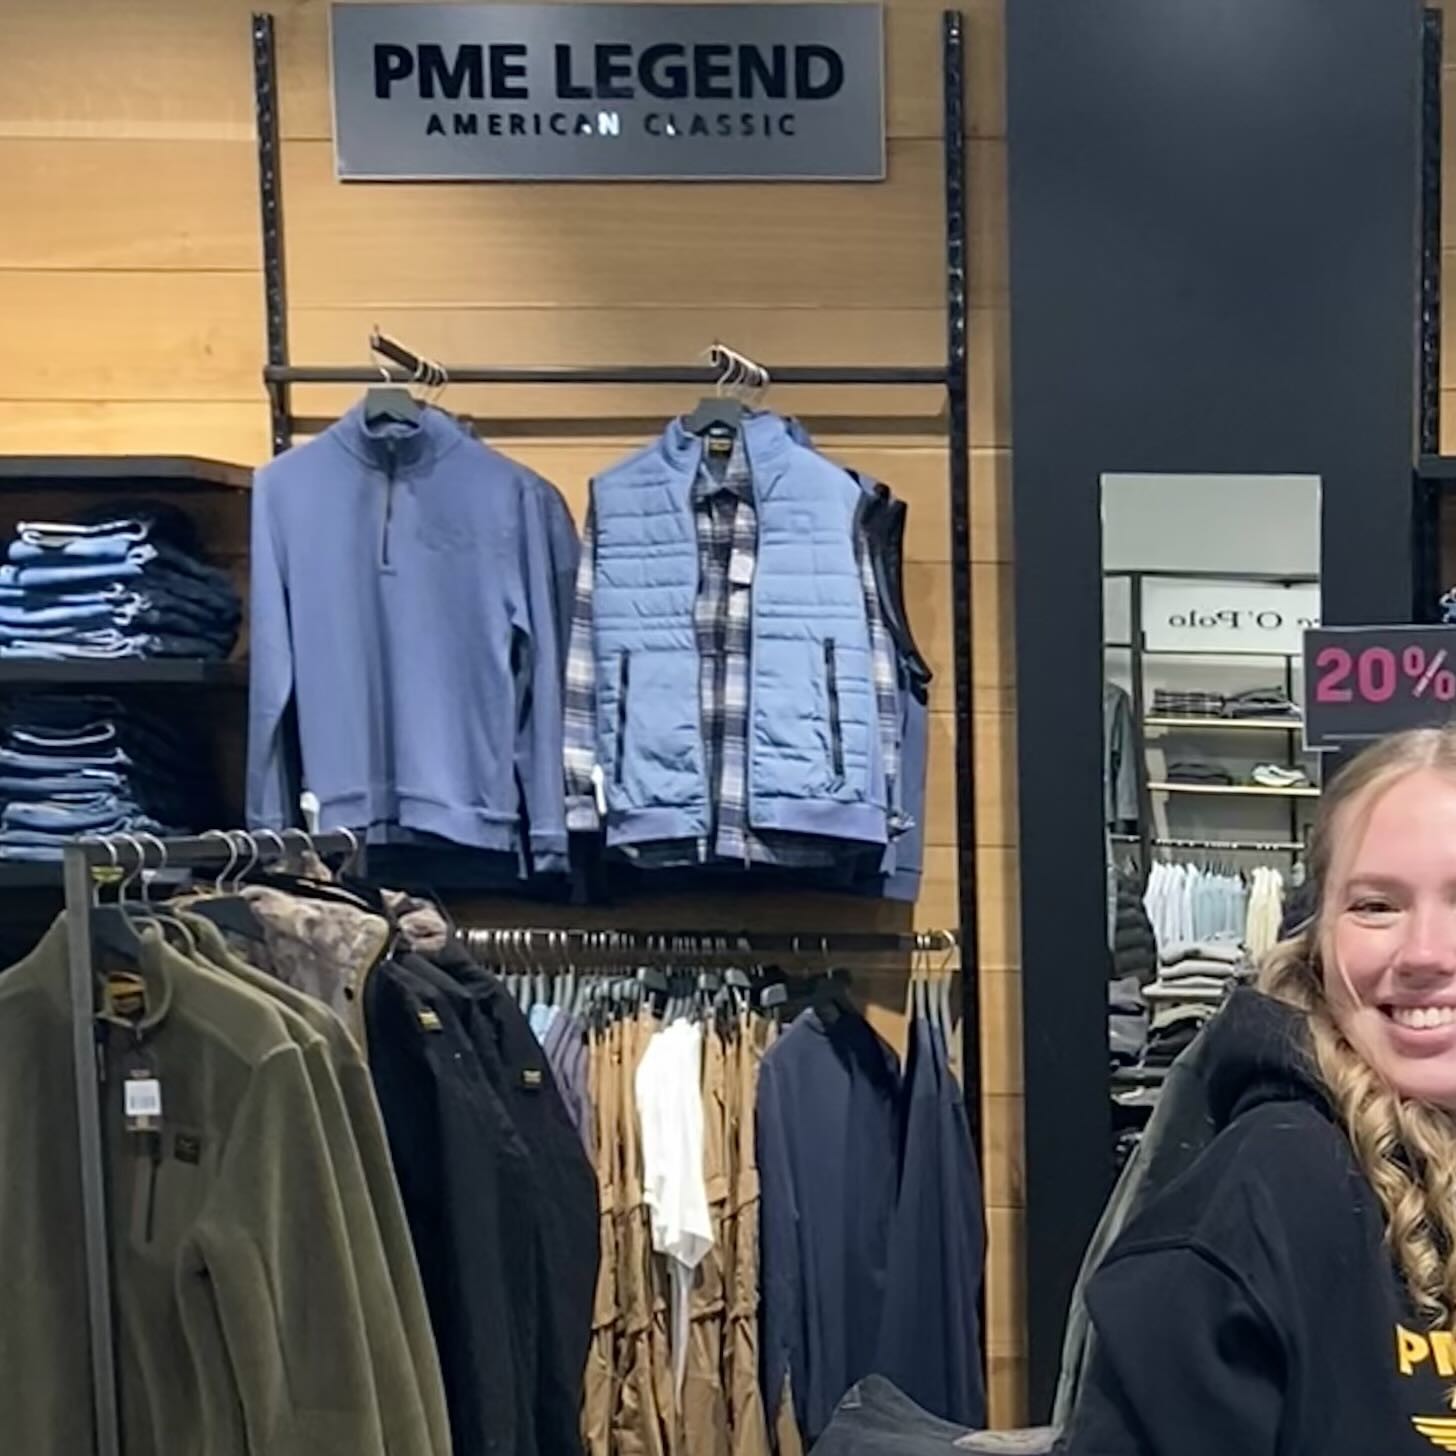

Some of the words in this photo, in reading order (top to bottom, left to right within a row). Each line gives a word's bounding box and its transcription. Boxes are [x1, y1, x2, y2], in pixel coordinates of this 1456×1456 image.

[373, 43, 528, 99] PME
[554, 43, 845, 100] LEGEND
[426, 112, 620, 136] AMERICAN
[643, 112, 797, 136] CLASSIC
[1315, 645, 1456, 702] 20%
